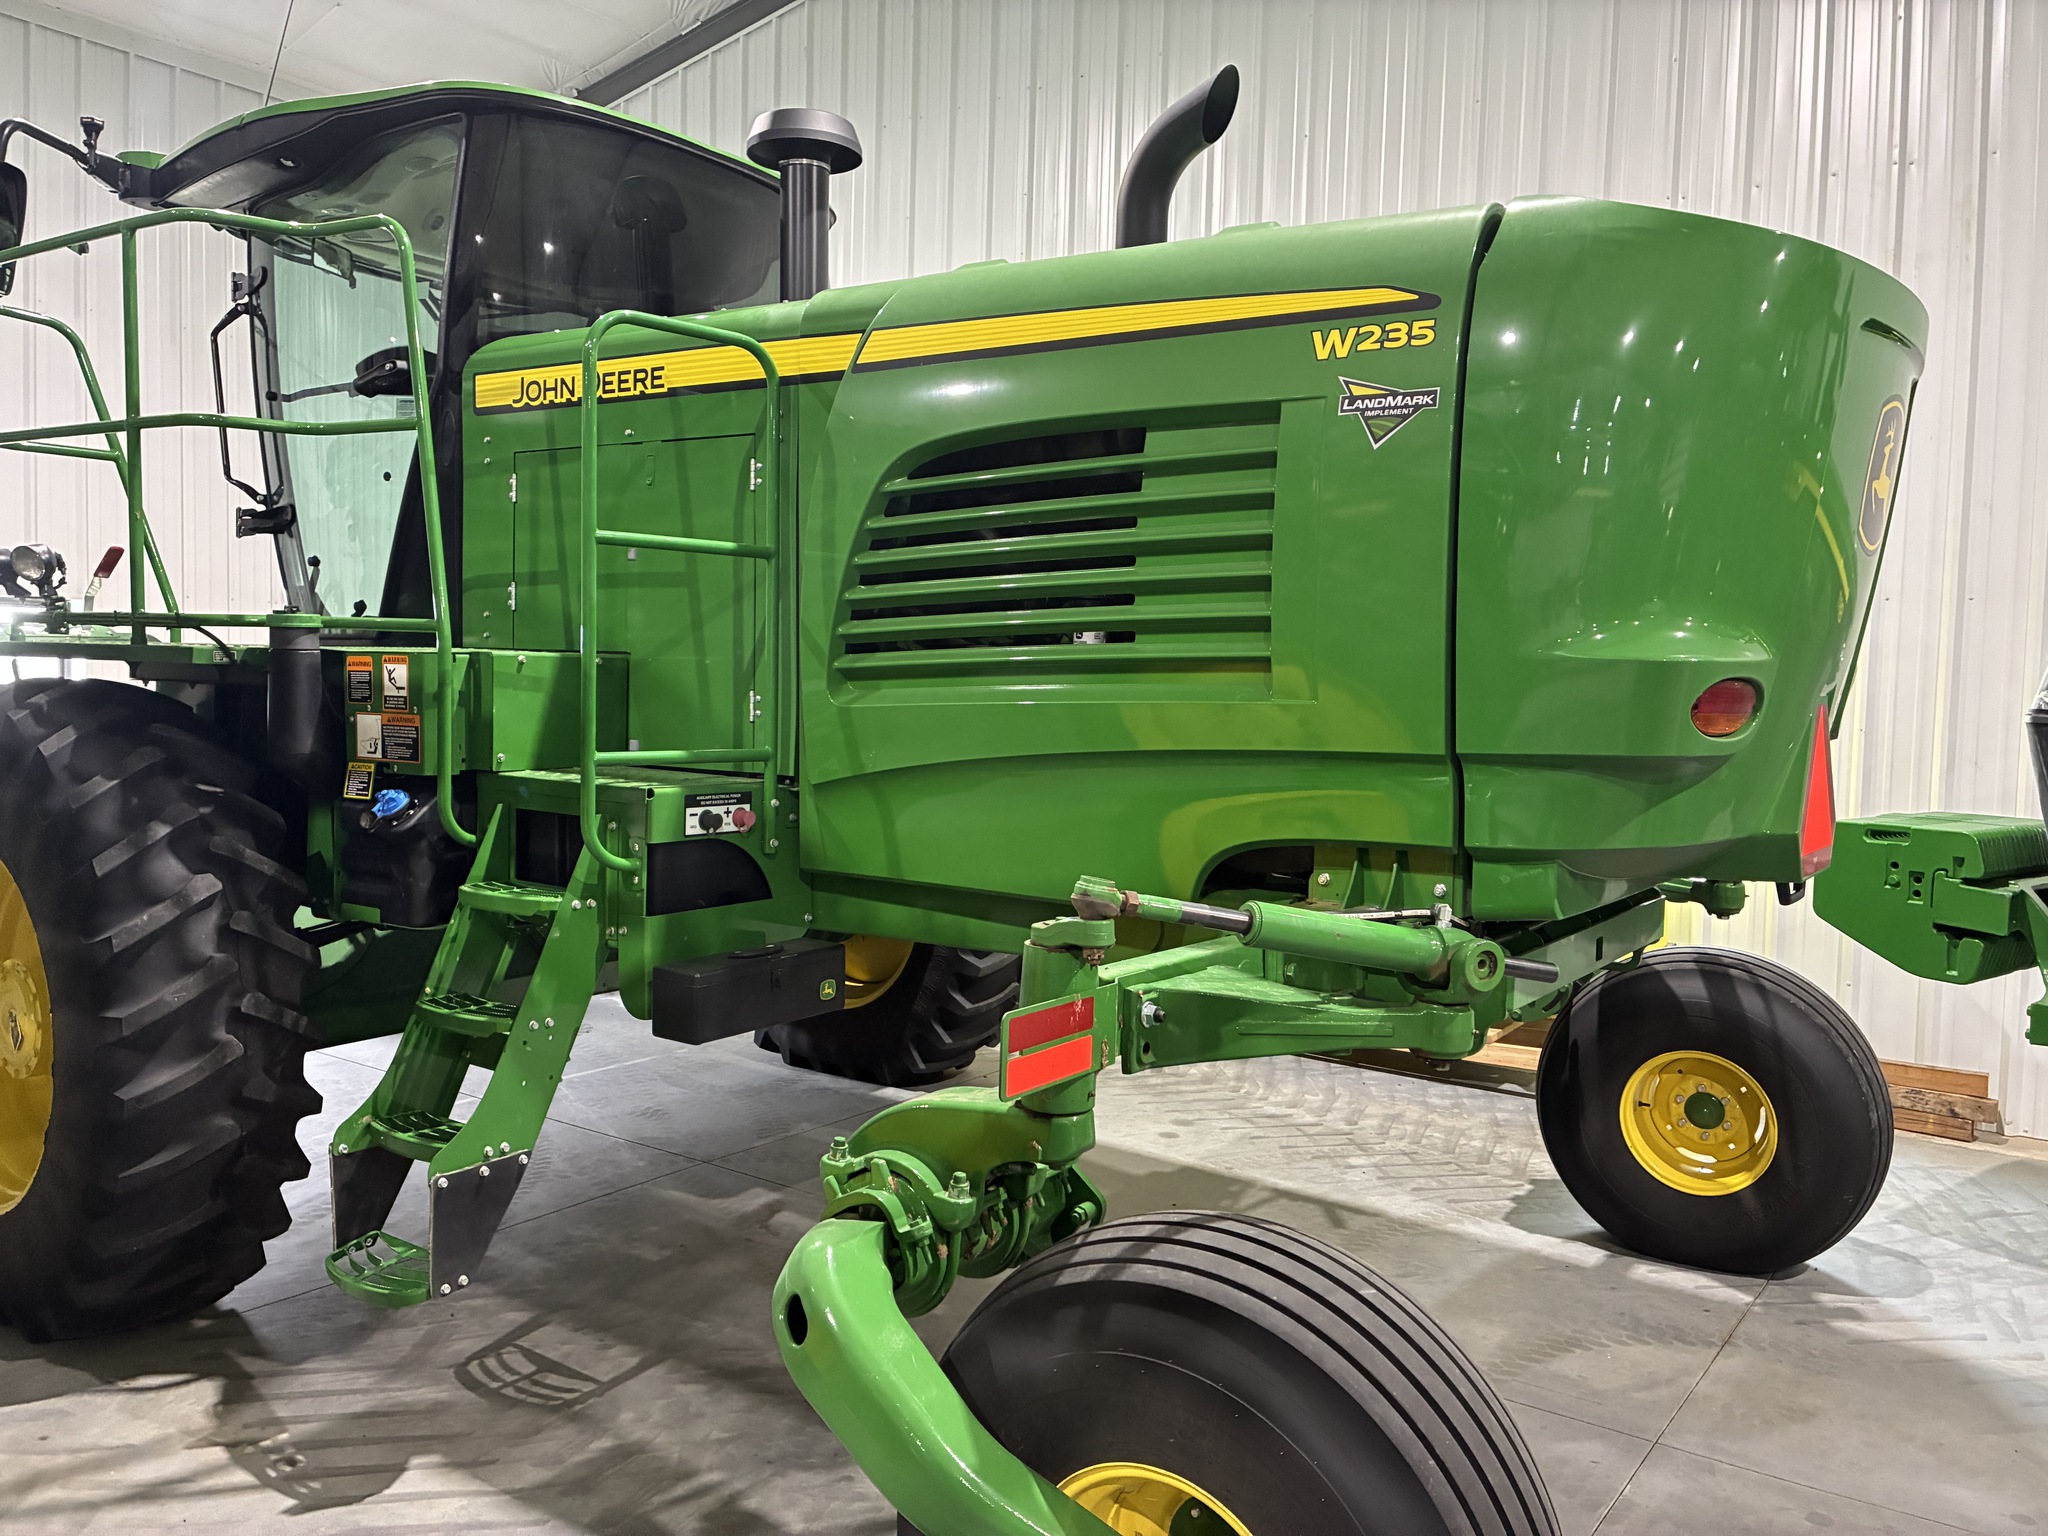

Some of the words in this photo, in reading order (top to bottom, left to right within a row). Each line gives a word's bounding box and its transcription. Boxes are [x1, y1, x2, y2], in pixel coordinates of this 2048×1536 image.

[1311, 318, 1437, 361] W235
[512, 376, 576, 404] JOHN
[596, 366, 665, 395] EERE
[1364, 407, 1414, 417] IMPLEMENT
